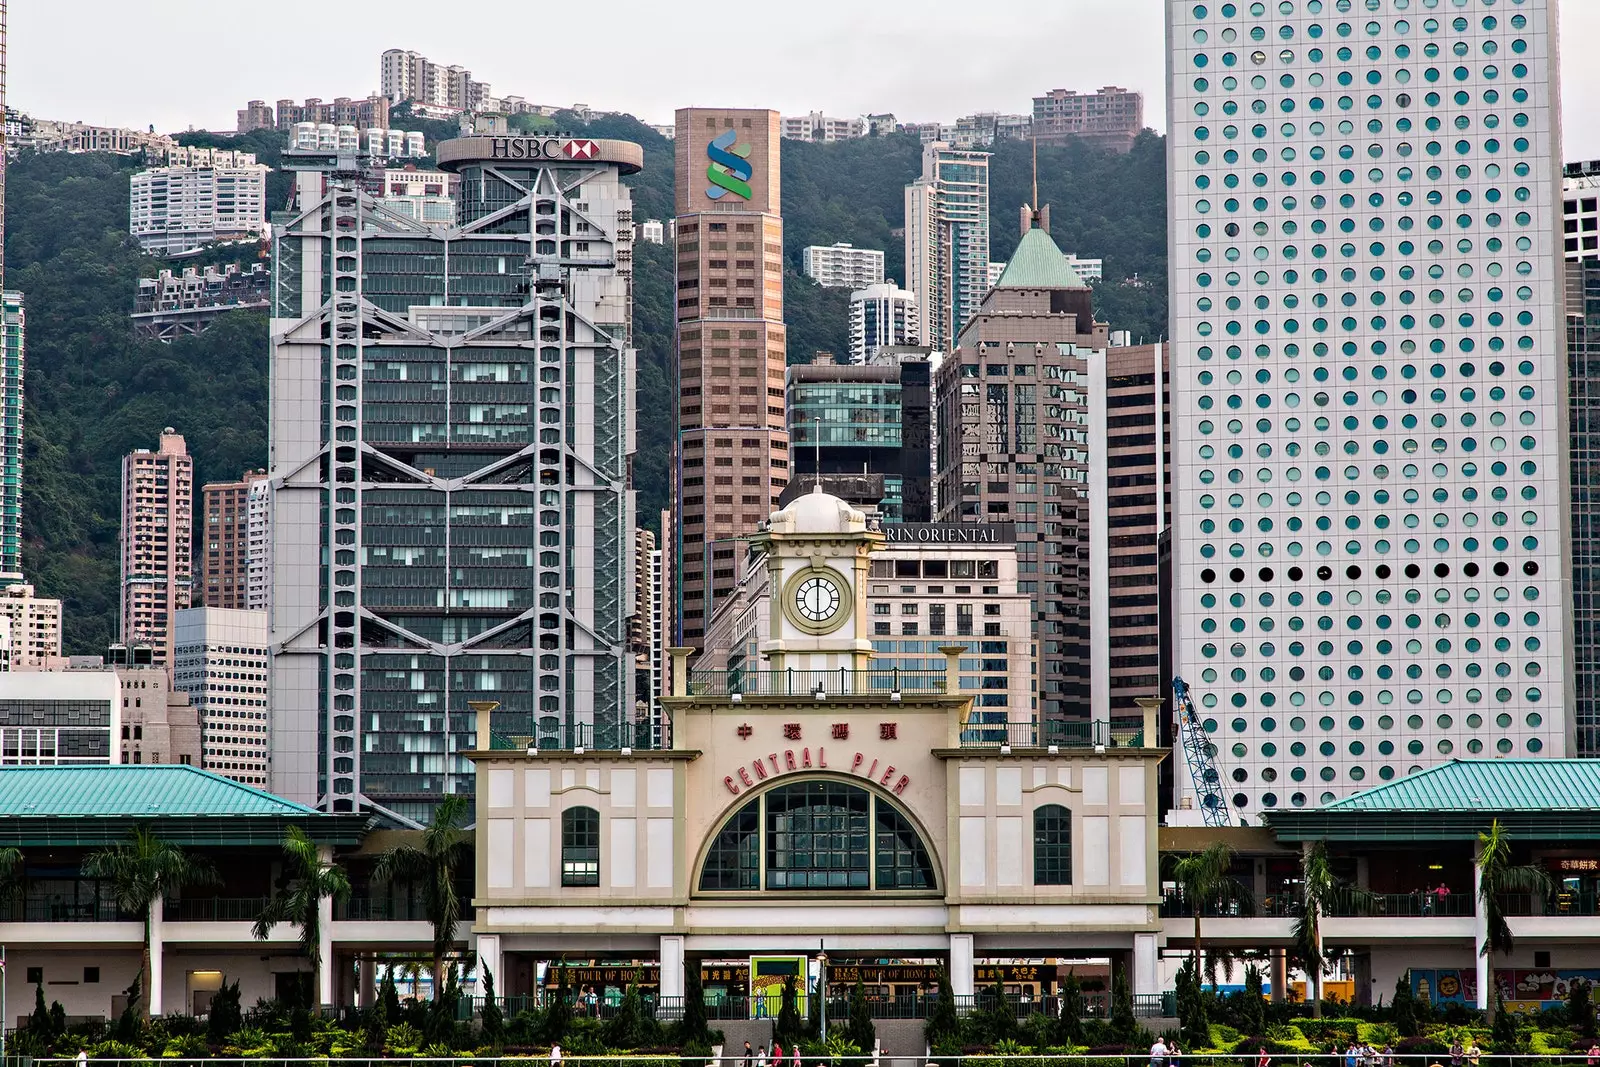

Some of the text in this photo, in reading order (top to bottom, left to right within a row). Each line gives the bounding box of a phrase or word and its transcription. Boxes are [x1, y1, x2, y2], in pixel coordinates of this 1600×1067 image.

[490, 138, 560, 159] HSBC
[918, 528, 999, 541] ORIENTAL
[737, 722, 898, 741] 中環碼頭
[724, 747, 910, 796] CENTRAL PIER
[1560, 859, 1598, 870] 奇華餅家
[580, 970, 601, 981] TOUR
[605, 970, 617, 981] OF
[863, 969, 886, 979] TOUR
[888, 969, 900, 979] OF
[903, 969, 926, 979] HONG
